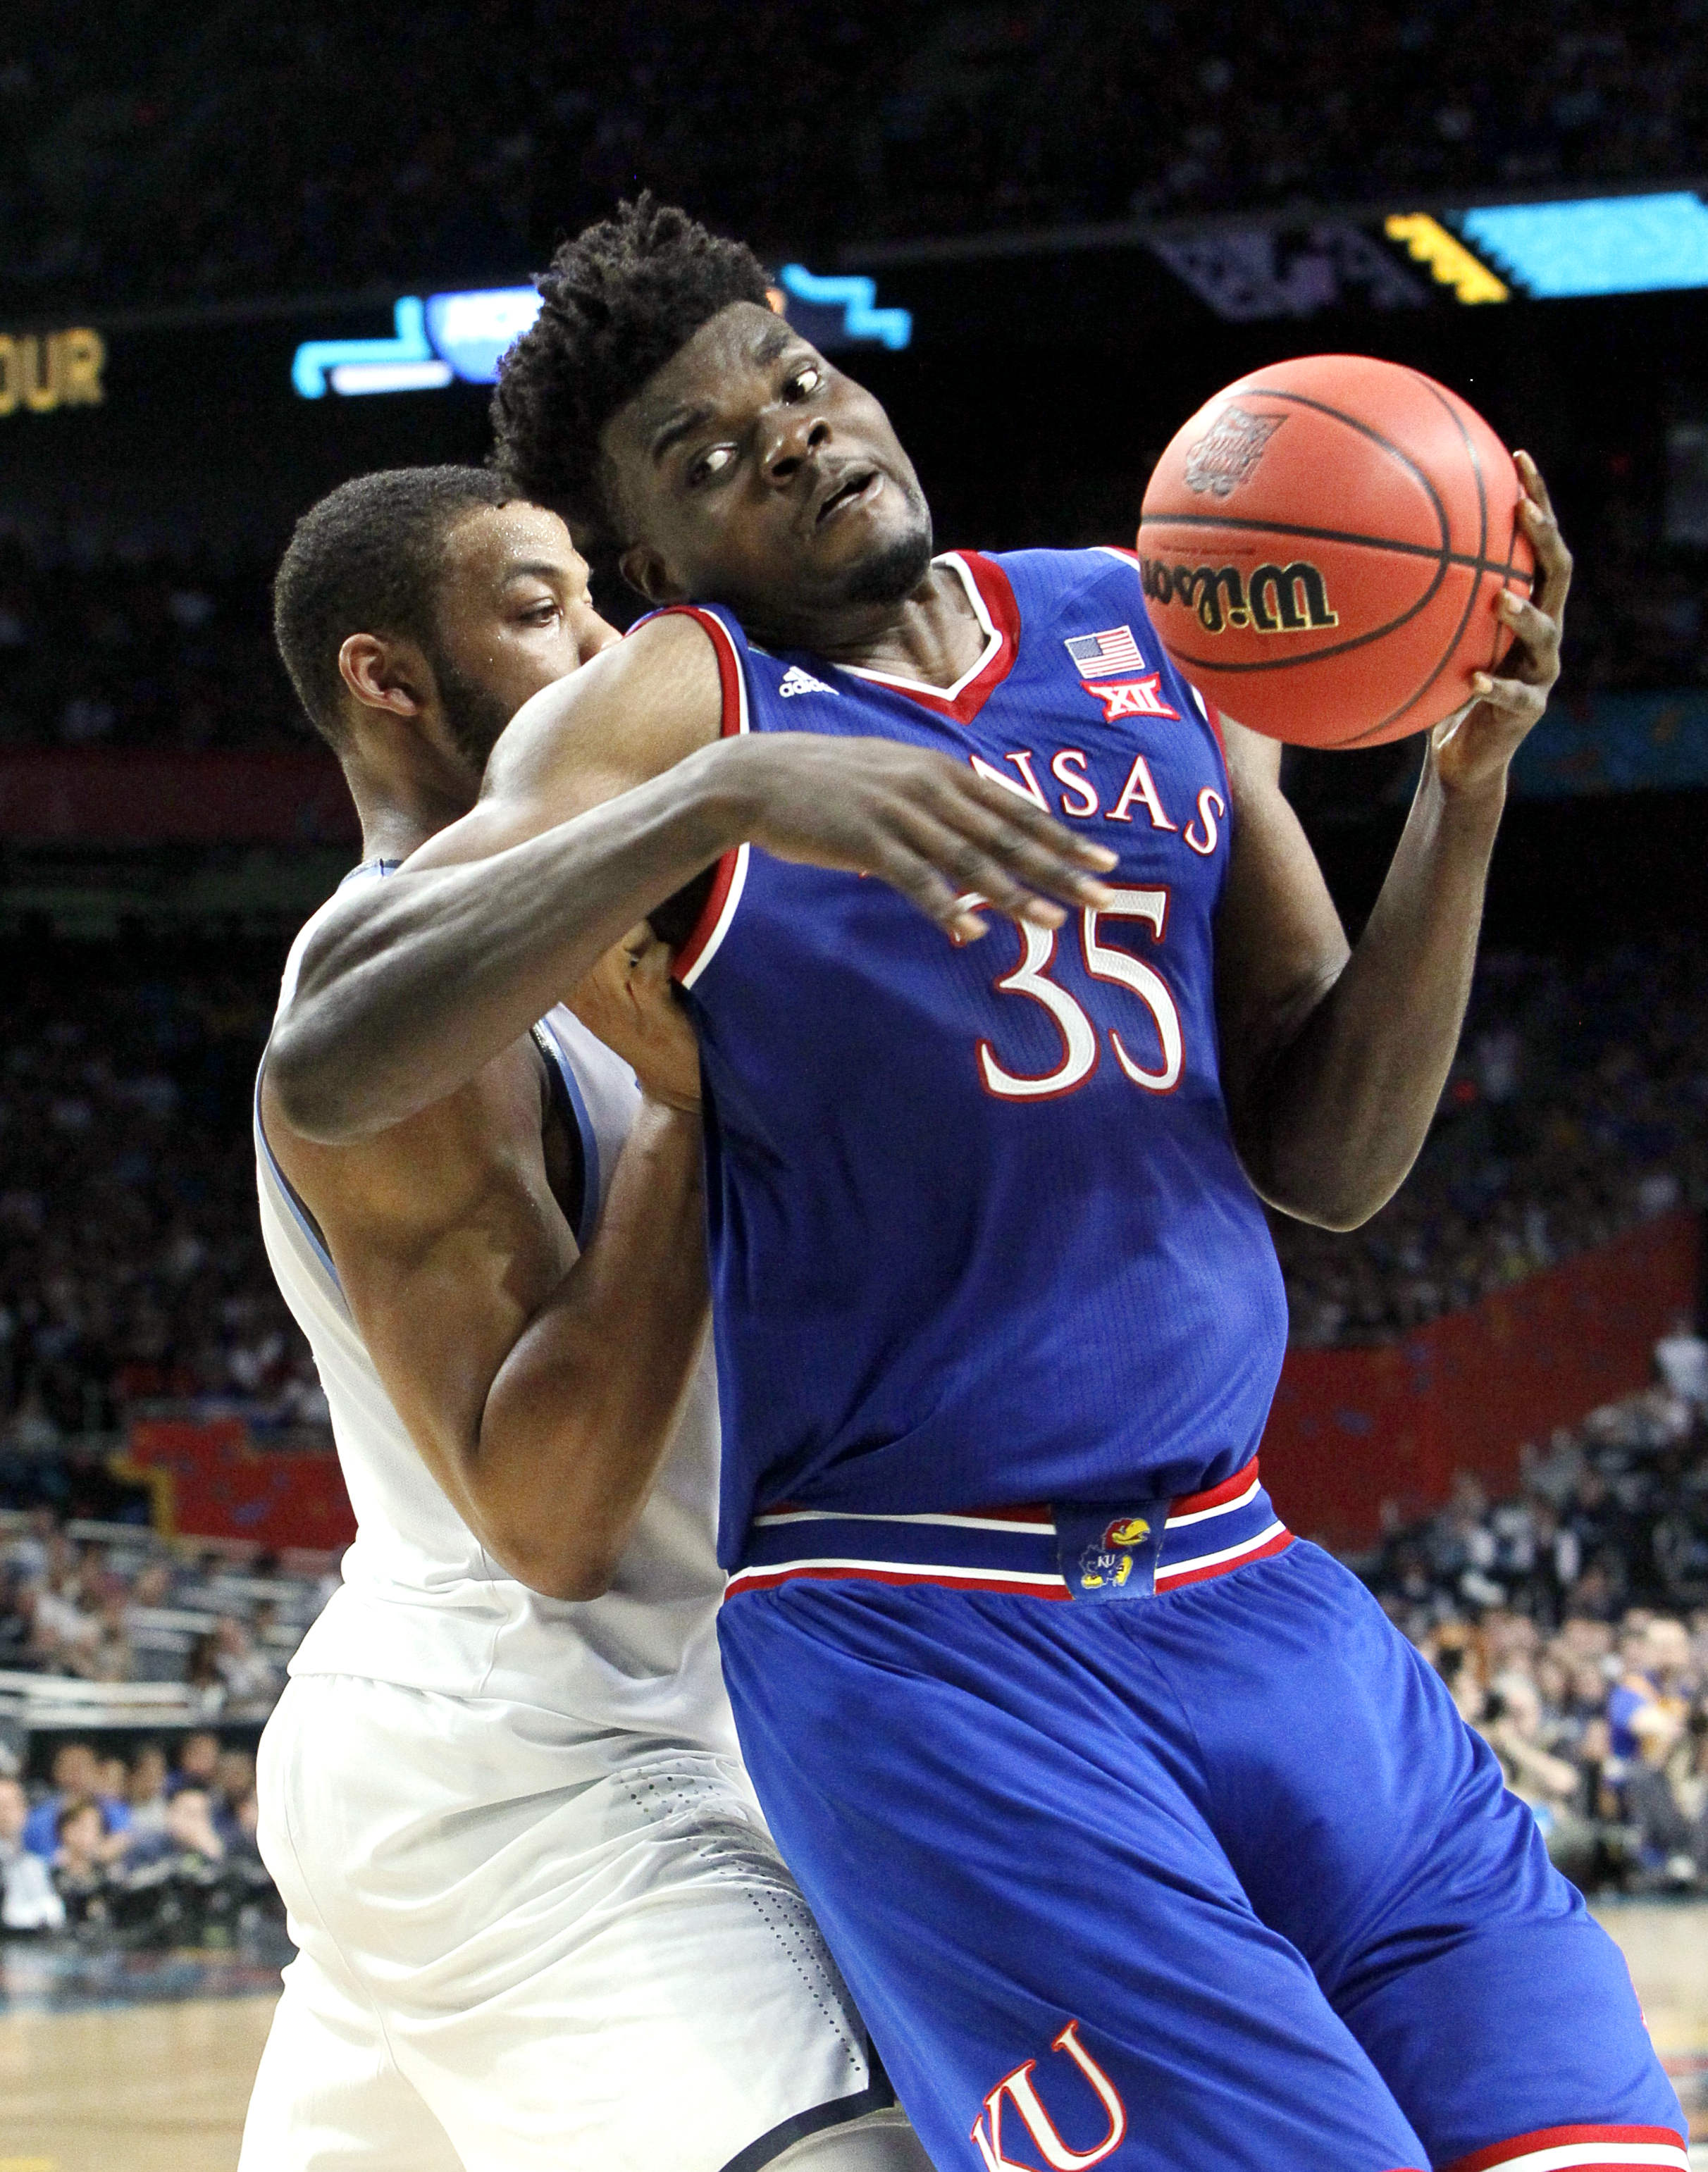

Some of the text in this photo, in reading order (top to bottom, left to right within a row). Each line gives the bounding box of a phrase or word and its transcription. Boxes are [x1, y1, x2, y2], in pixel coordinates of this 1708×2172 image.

[970, 749, 1225, 856] NSAS
[952, 883, 1187, 1103] 35
[1097, 1553, 1116, 1568] KU
[970, 2019, 1127, 2172] KU
